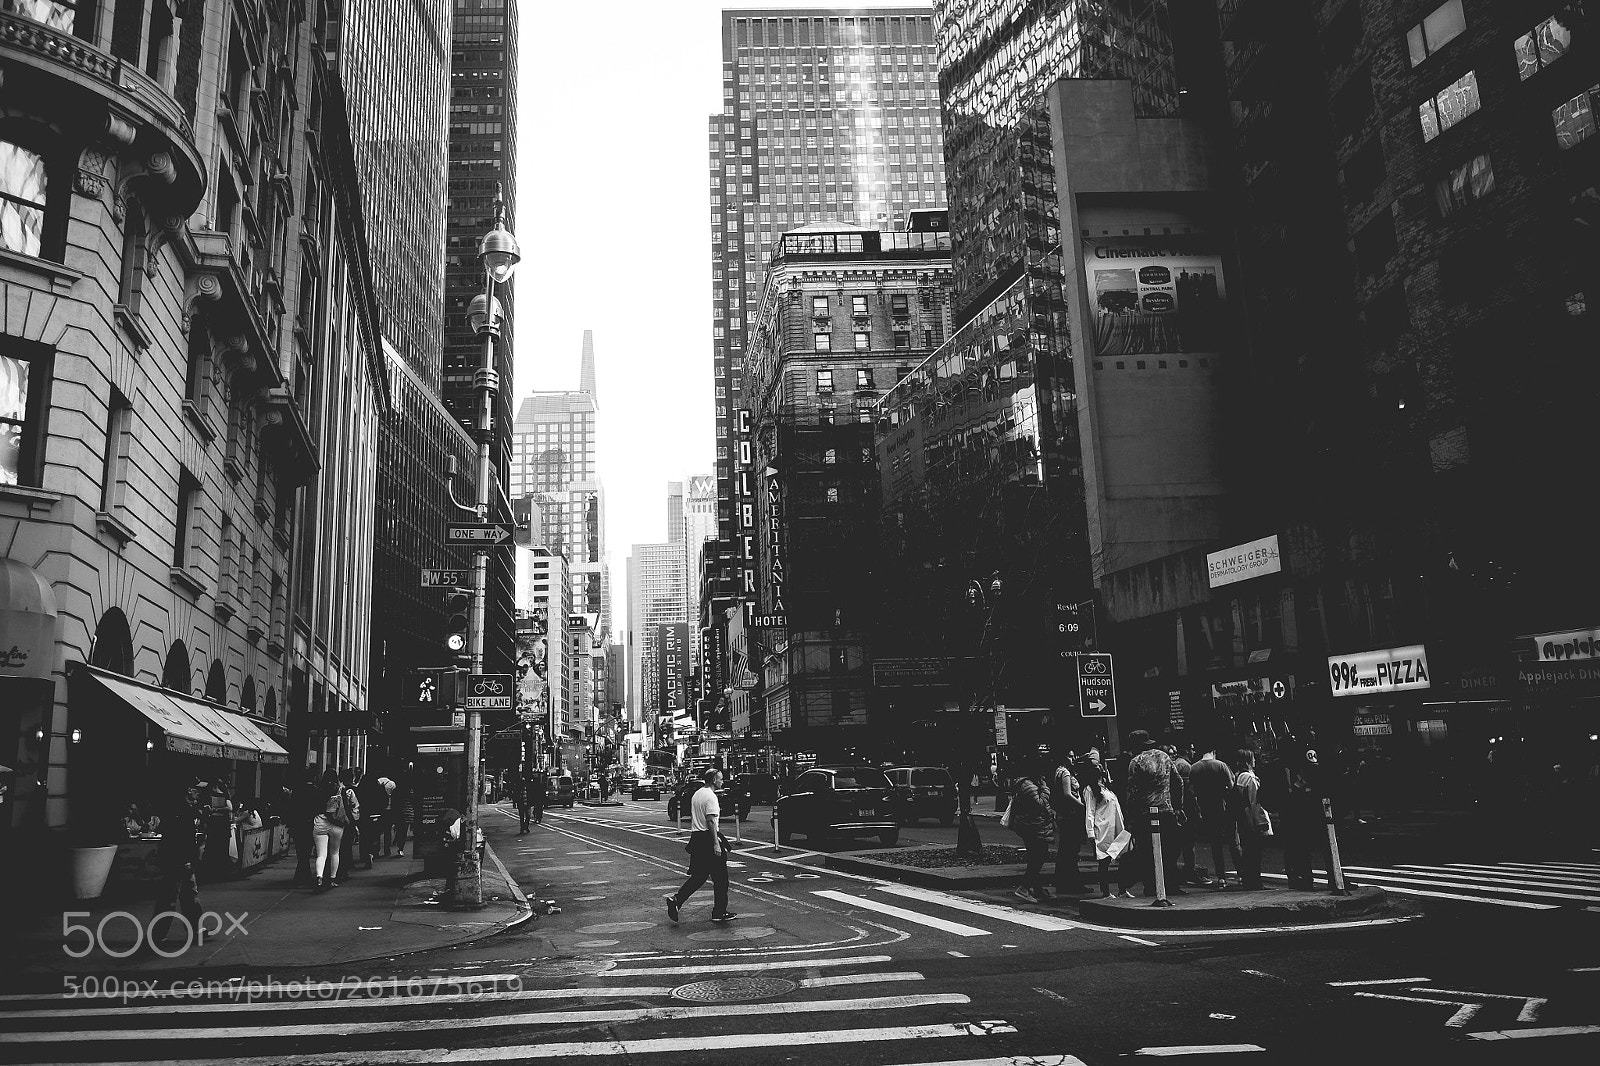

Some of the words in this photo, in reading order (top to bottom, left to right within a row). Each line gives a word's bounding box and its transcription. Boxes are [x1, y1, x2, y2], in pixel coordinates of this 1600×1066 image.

[1094, 245, 1165, 259] Cinematic
[740, 410, 755, 626] COLBERT
[454, 530, 475, 538] ONE
[483, 530, 504, 538] WAY
[769, 478, 785, 611] AMERITANIA
[1209, 548, 1268, 571] SCHWEIGER
[1210, 565, 1249, 579] DERMATOLOGY
[1249, 558, 1269, 569] GROUP
[430, 571, 441, 584] W
[442, 571, 458, 584] 55
[1059, 623, 1079, 632] 6:09
[666, 626, 675, 651] RIM
[667, 654, 677, 708] PACIFIC
[1081, 677, 1111, 686] Hudson
[1331, 661, 1358, 690] 99¢
[1360, 677, 1377, 688] FRESH
[1376, 658, 1428, 685] PIZZA
[1518, 668, 1576, 685] Applejack
[1461, 676, 1496, 689] DINER
[1086, 688, 1108, 697] River
[468, 698, 486, 706] BIKE
[489, 698, 510, 706] LANE
